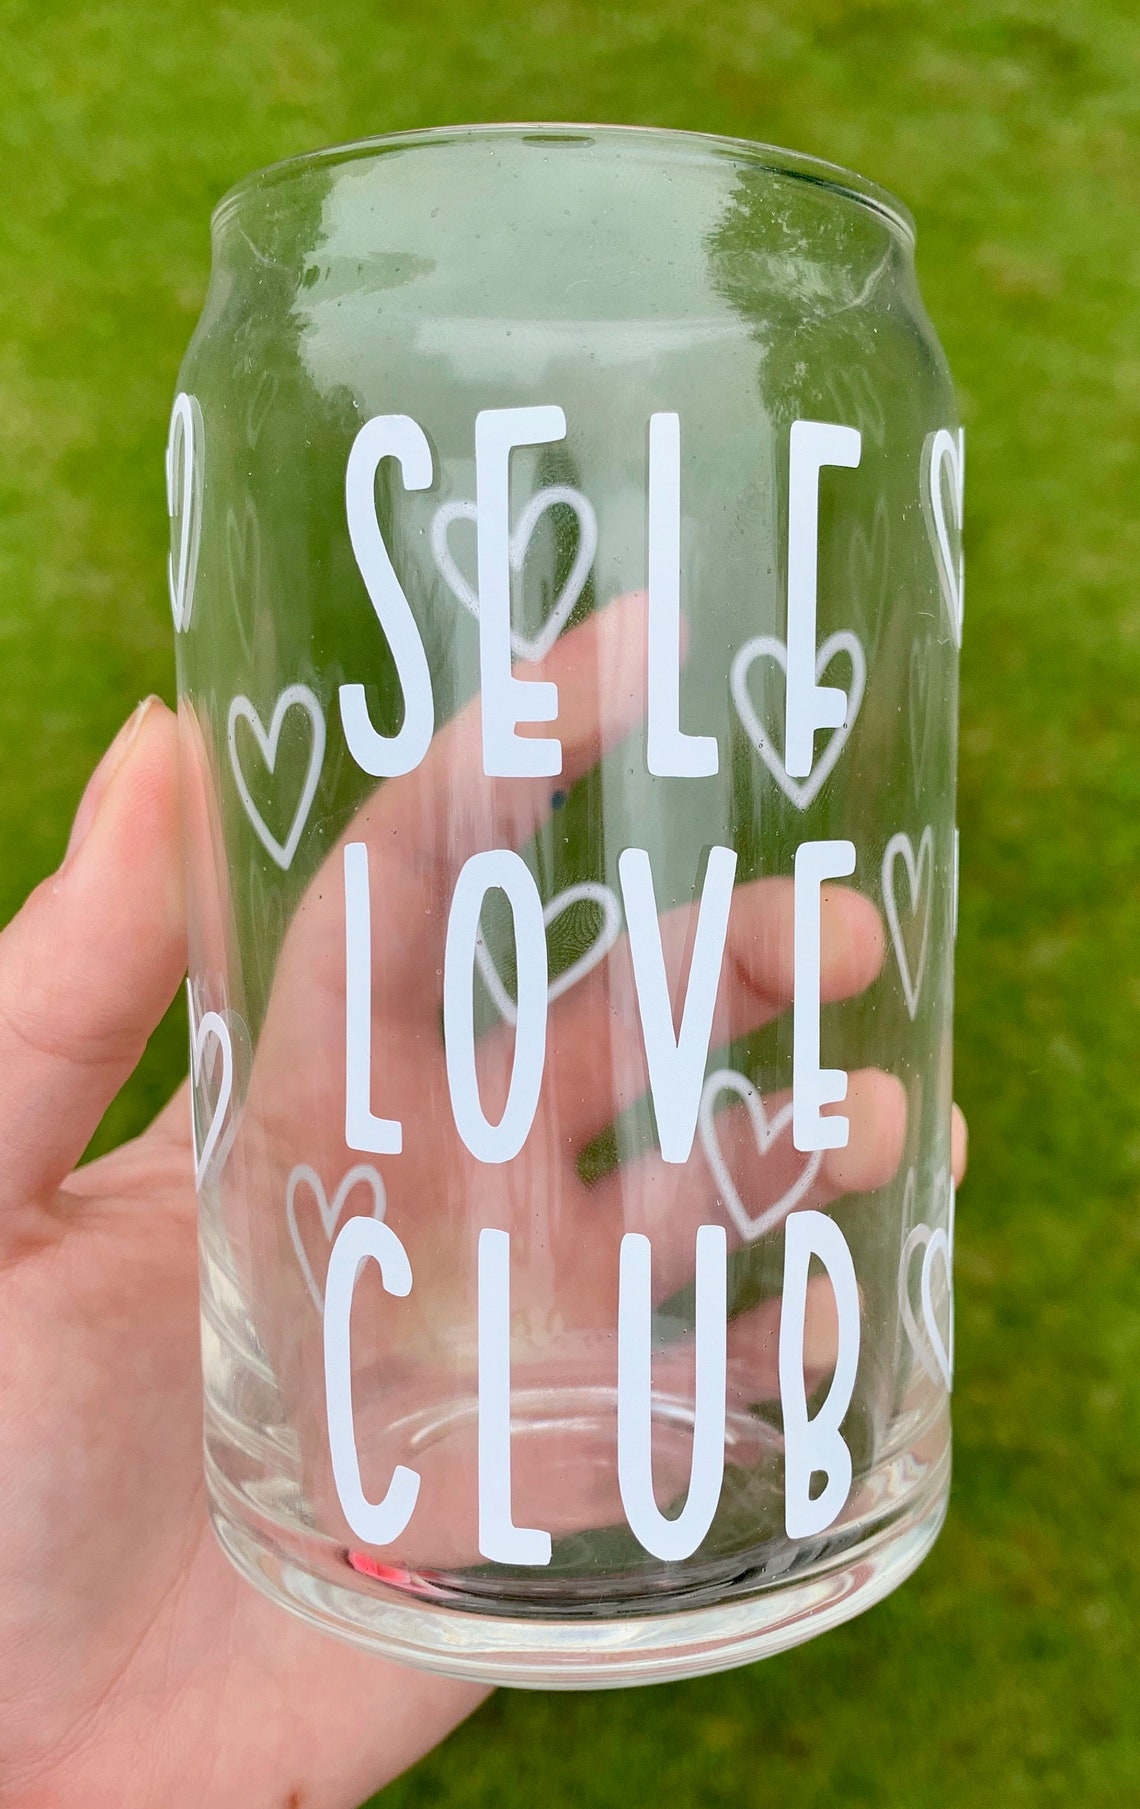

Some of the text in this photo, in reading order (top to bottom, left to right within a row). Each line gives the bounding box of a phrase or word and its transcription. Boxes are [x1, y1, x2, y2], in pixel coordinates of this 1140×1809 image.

[339, 405, 862, 778] SELF
[344, 840, 857, 1164] LOVE
[324, 1211, 861, 1566] CLUB
